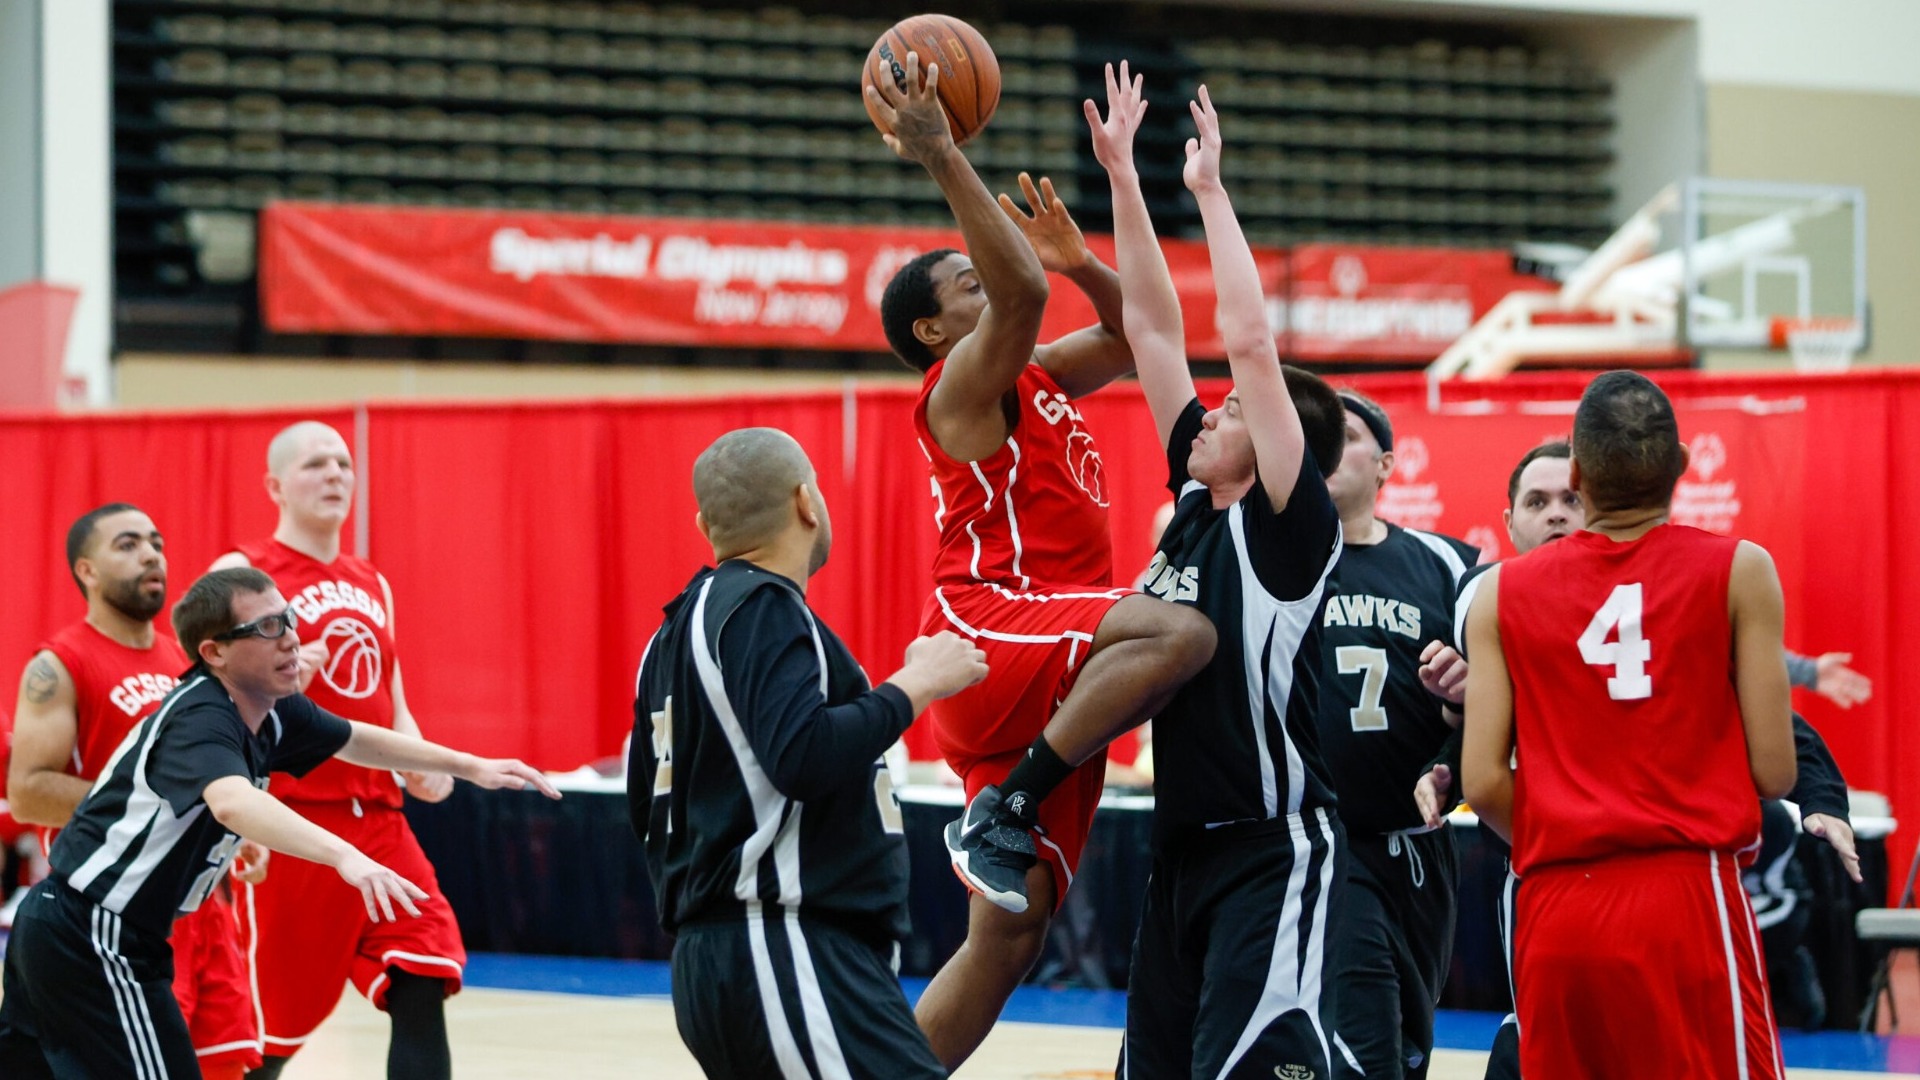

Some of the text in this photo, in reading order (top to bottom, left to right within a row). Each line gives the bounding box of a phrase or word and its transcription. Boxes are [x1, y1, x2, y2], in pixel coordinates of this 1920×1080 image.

[490, 228, 848, 288] Special Olympics
[1324, 594, 1421, 640] AWKS
[1577, 582, 1652, 700] 4
[109, 672, 182, 717] GCSS
[1335, 645, 1389, 732] 7
